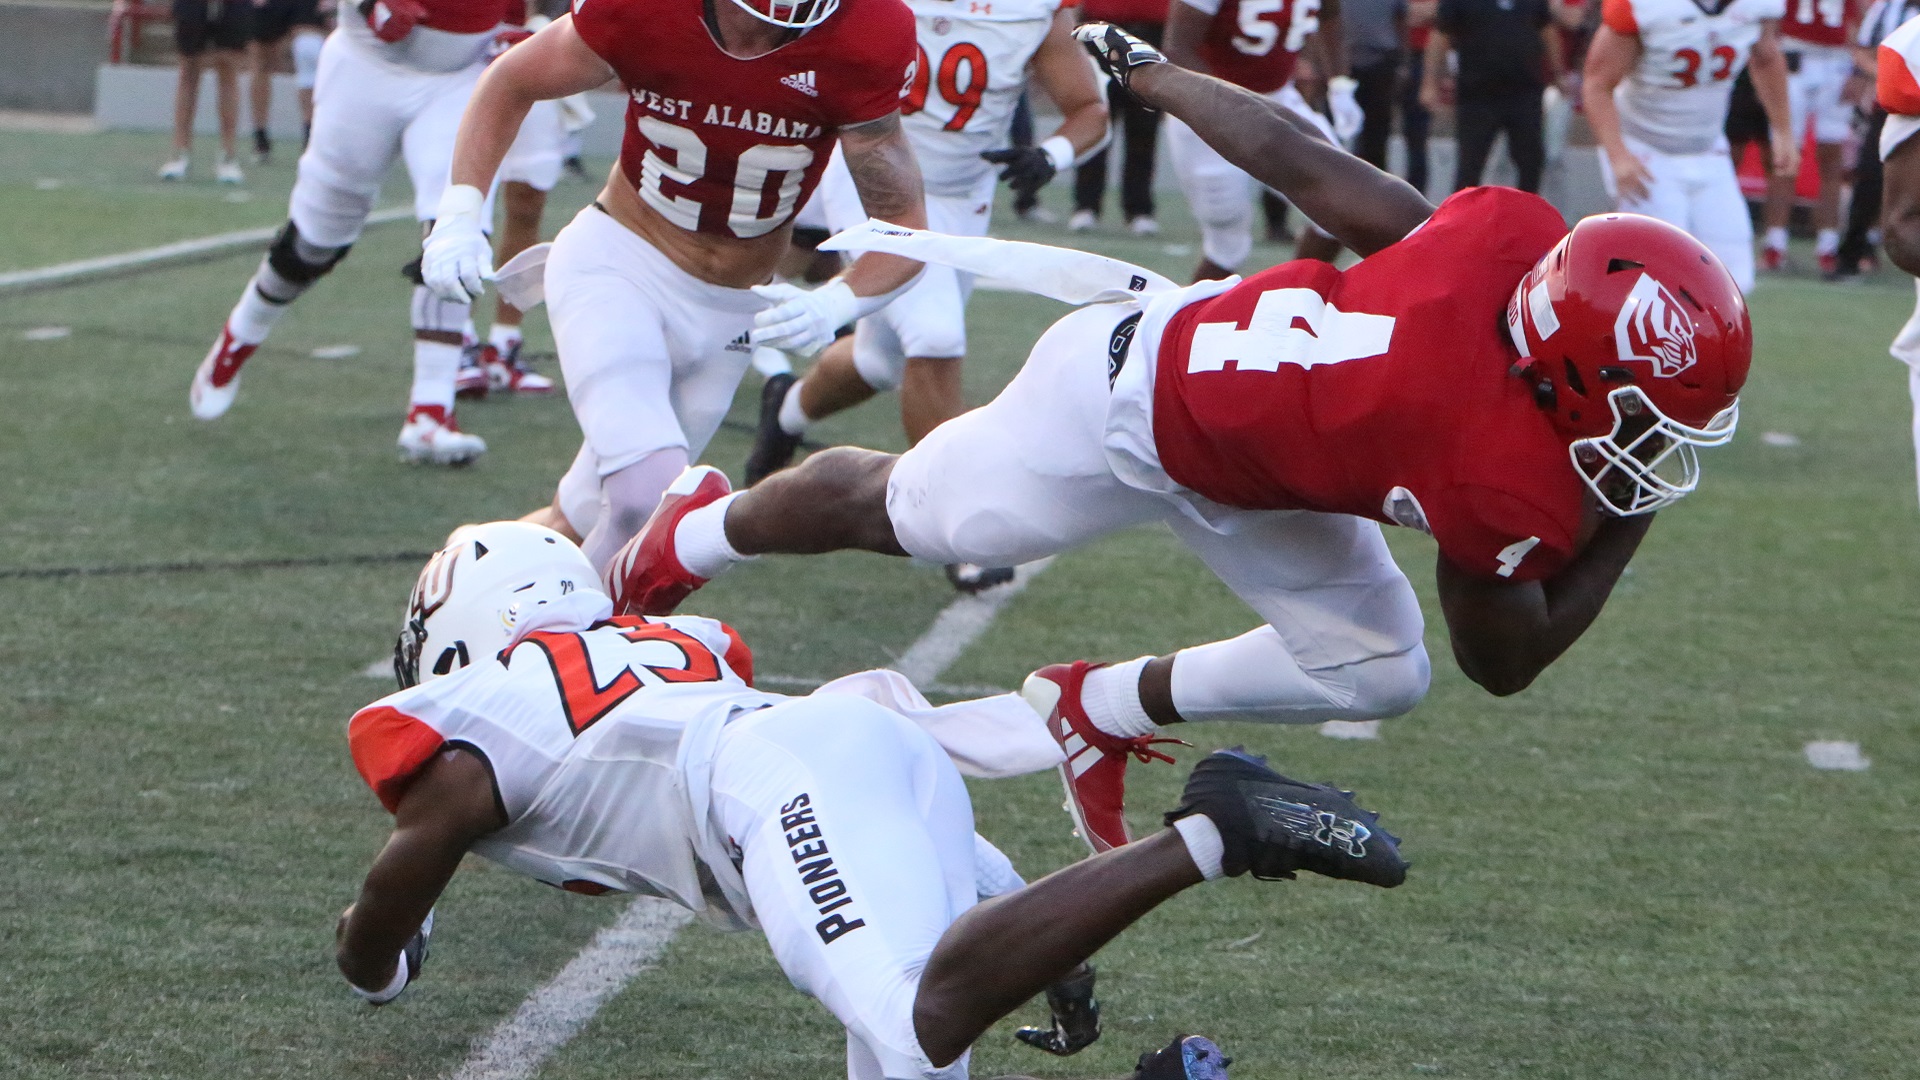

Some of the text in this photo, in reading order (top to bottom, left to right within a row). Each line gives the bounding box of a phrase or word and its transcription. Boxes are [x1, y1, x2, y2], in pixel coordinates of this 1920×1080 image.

[630, 87, 693, 121] WEST
[780, 76, 819, 97] adidas
[637, 114, 814, 239] 20
[1187, 287, 1397, 374] 4
[1495, 535, 1541, 578] 4
[780, 792, 867, 946] PIONEERS
